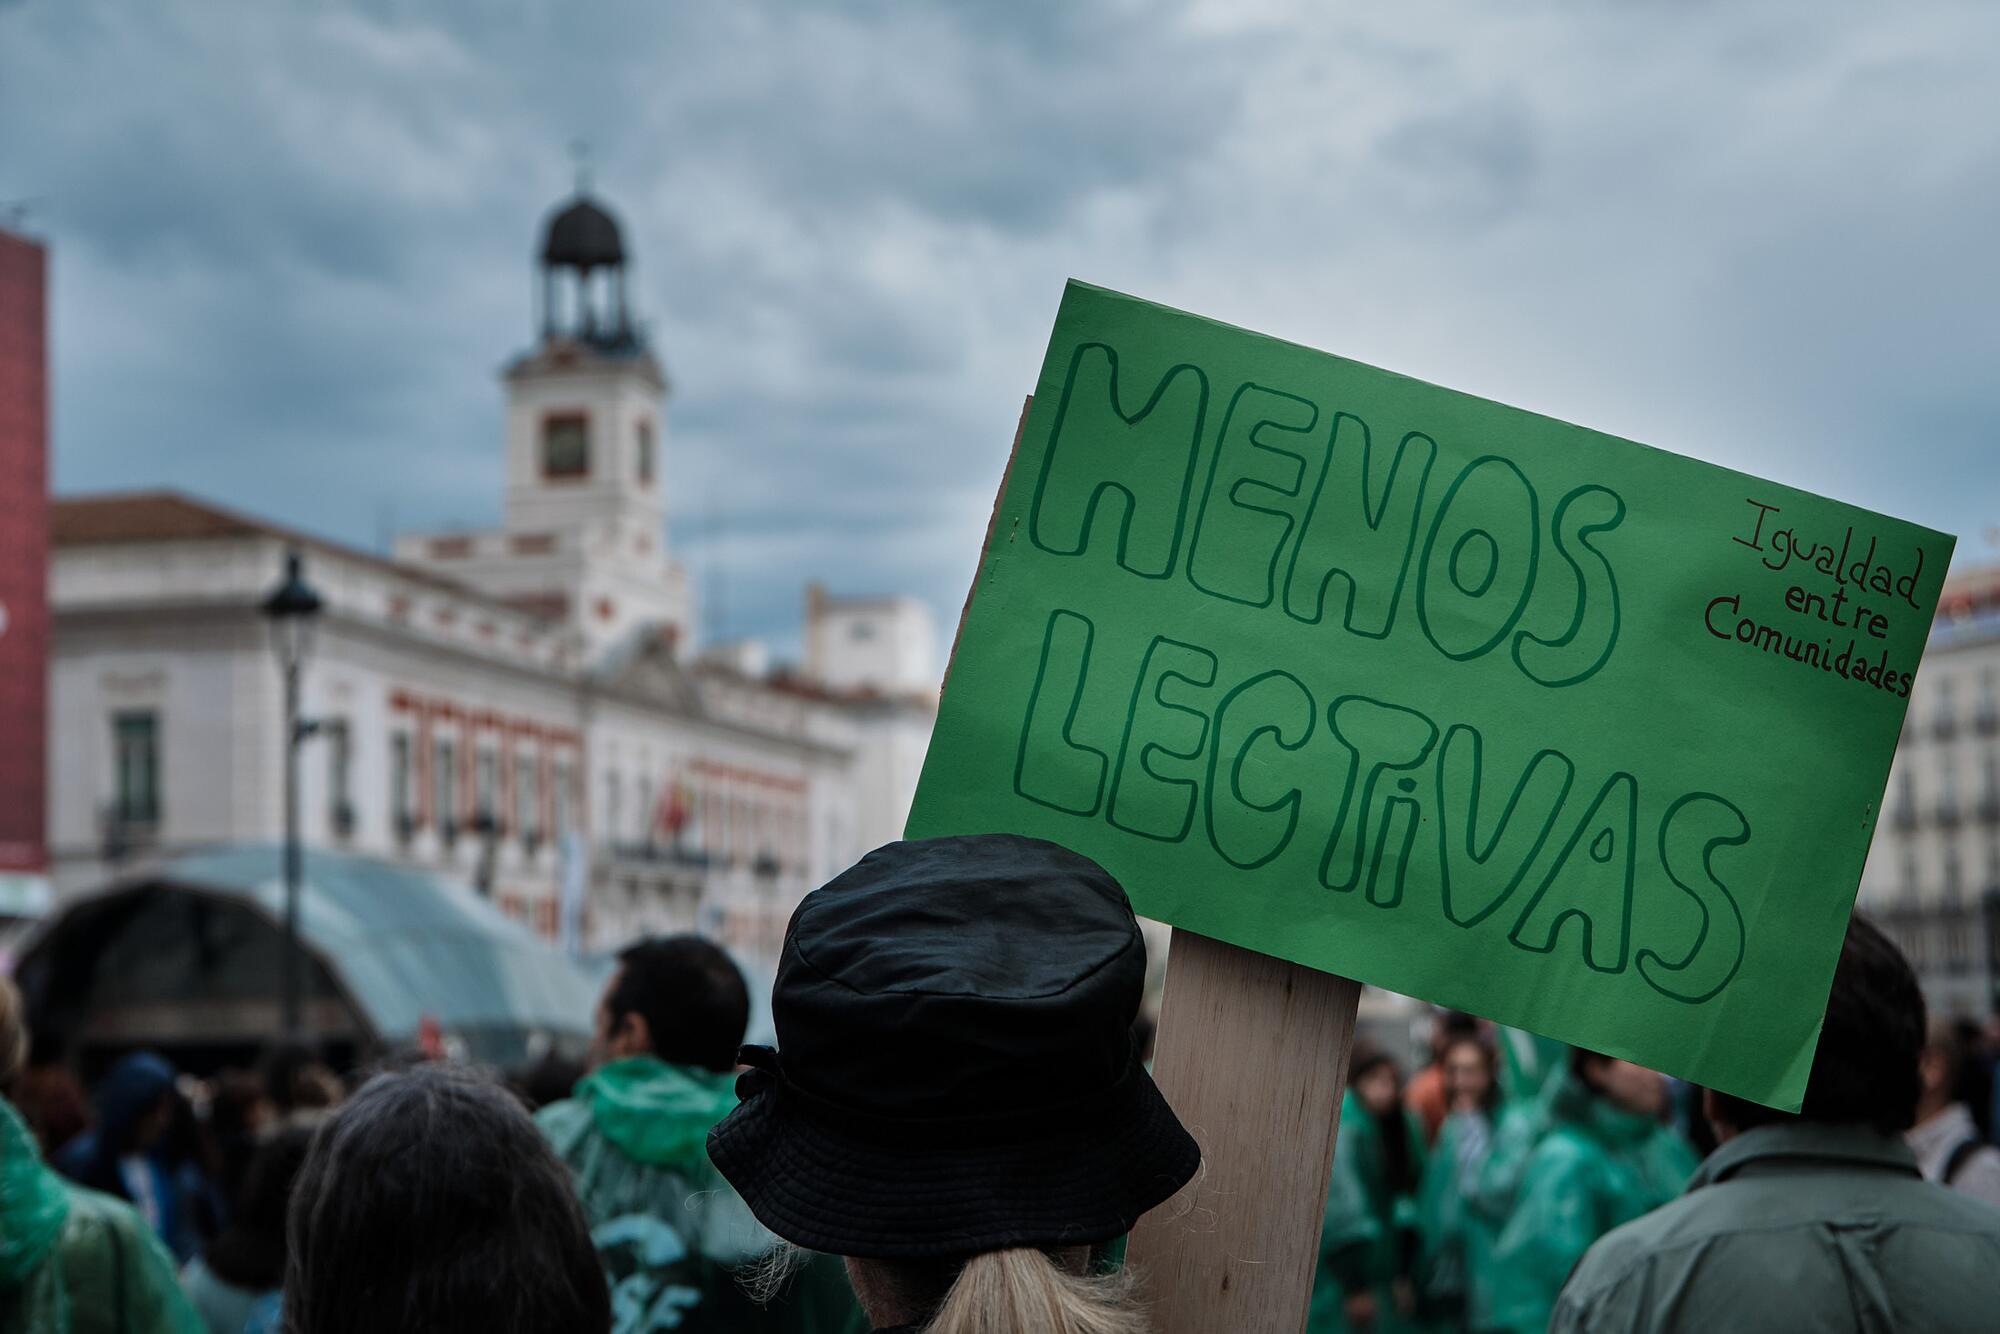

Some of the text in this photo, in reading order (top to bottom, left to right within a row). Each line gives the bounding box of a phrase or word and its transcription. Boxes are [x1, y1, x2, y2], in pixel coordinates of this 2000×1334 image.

[1030, 342, 1626, 688] MENOS
[1733, 498, 1924, 610] Igualdad
[1705, 594, 1912, 698] Comunidades
[1785, 586, 1889, 639] entre
